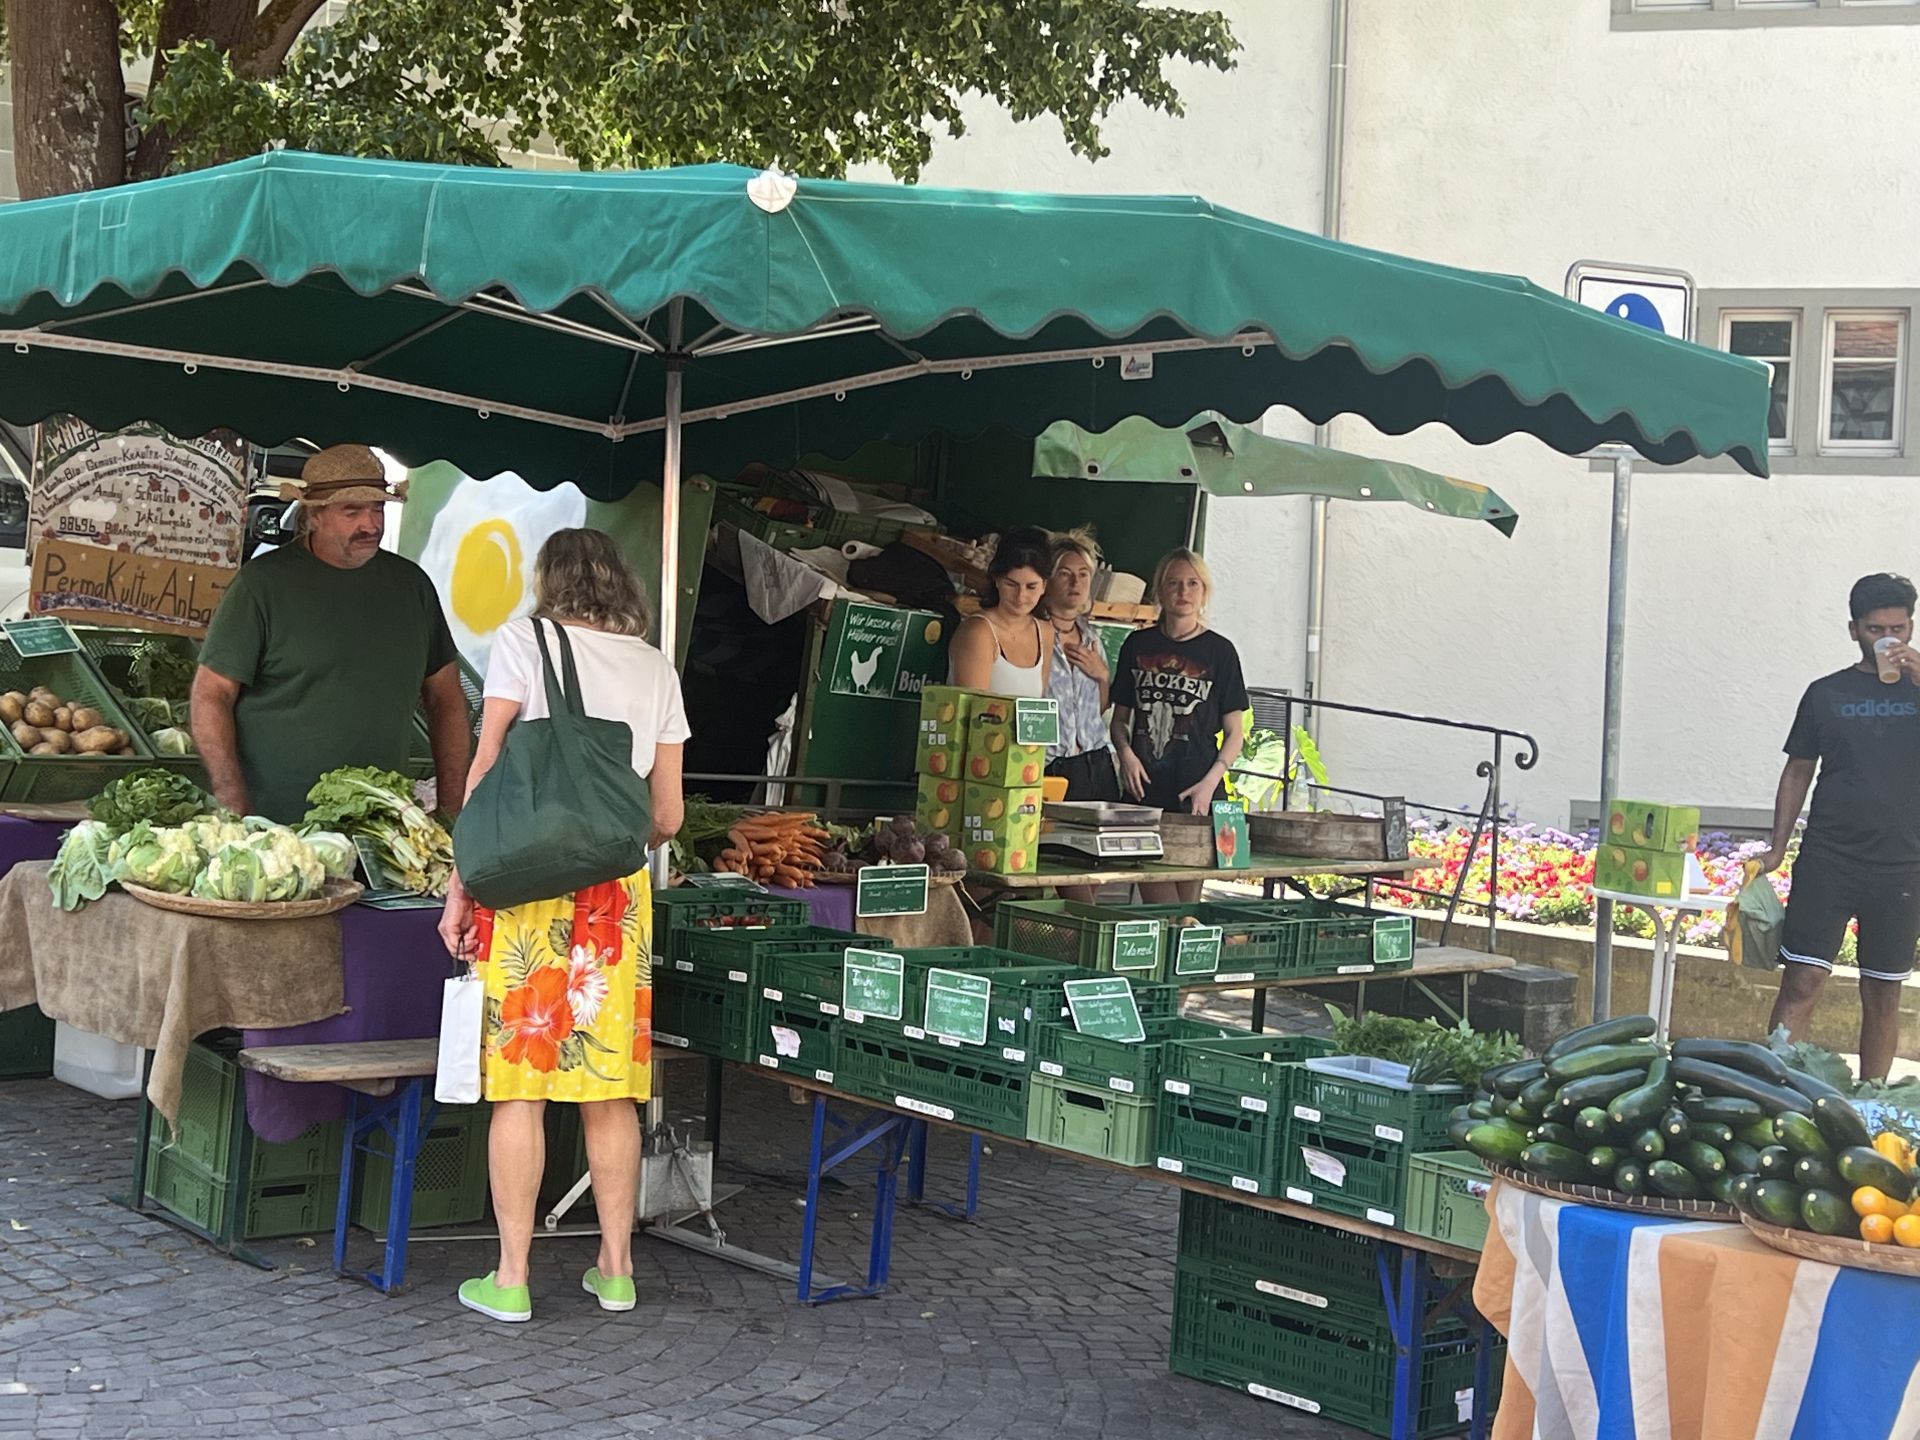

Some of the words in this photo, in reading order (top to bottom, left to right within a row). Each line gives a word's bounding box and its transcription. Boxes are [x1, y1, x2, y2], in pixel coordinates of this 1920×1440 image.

[59, 516, 97, 532] 88696
[849, 613, 865, 626] Wir
[866, 614, 890, 629] lassen
[847, 628, 876, 643] Hühner
[1141, 689, 1188, 704] 2024
[1841, 699, 1916, 717] adidas
[1122, 941, 1154, 957] Idared
